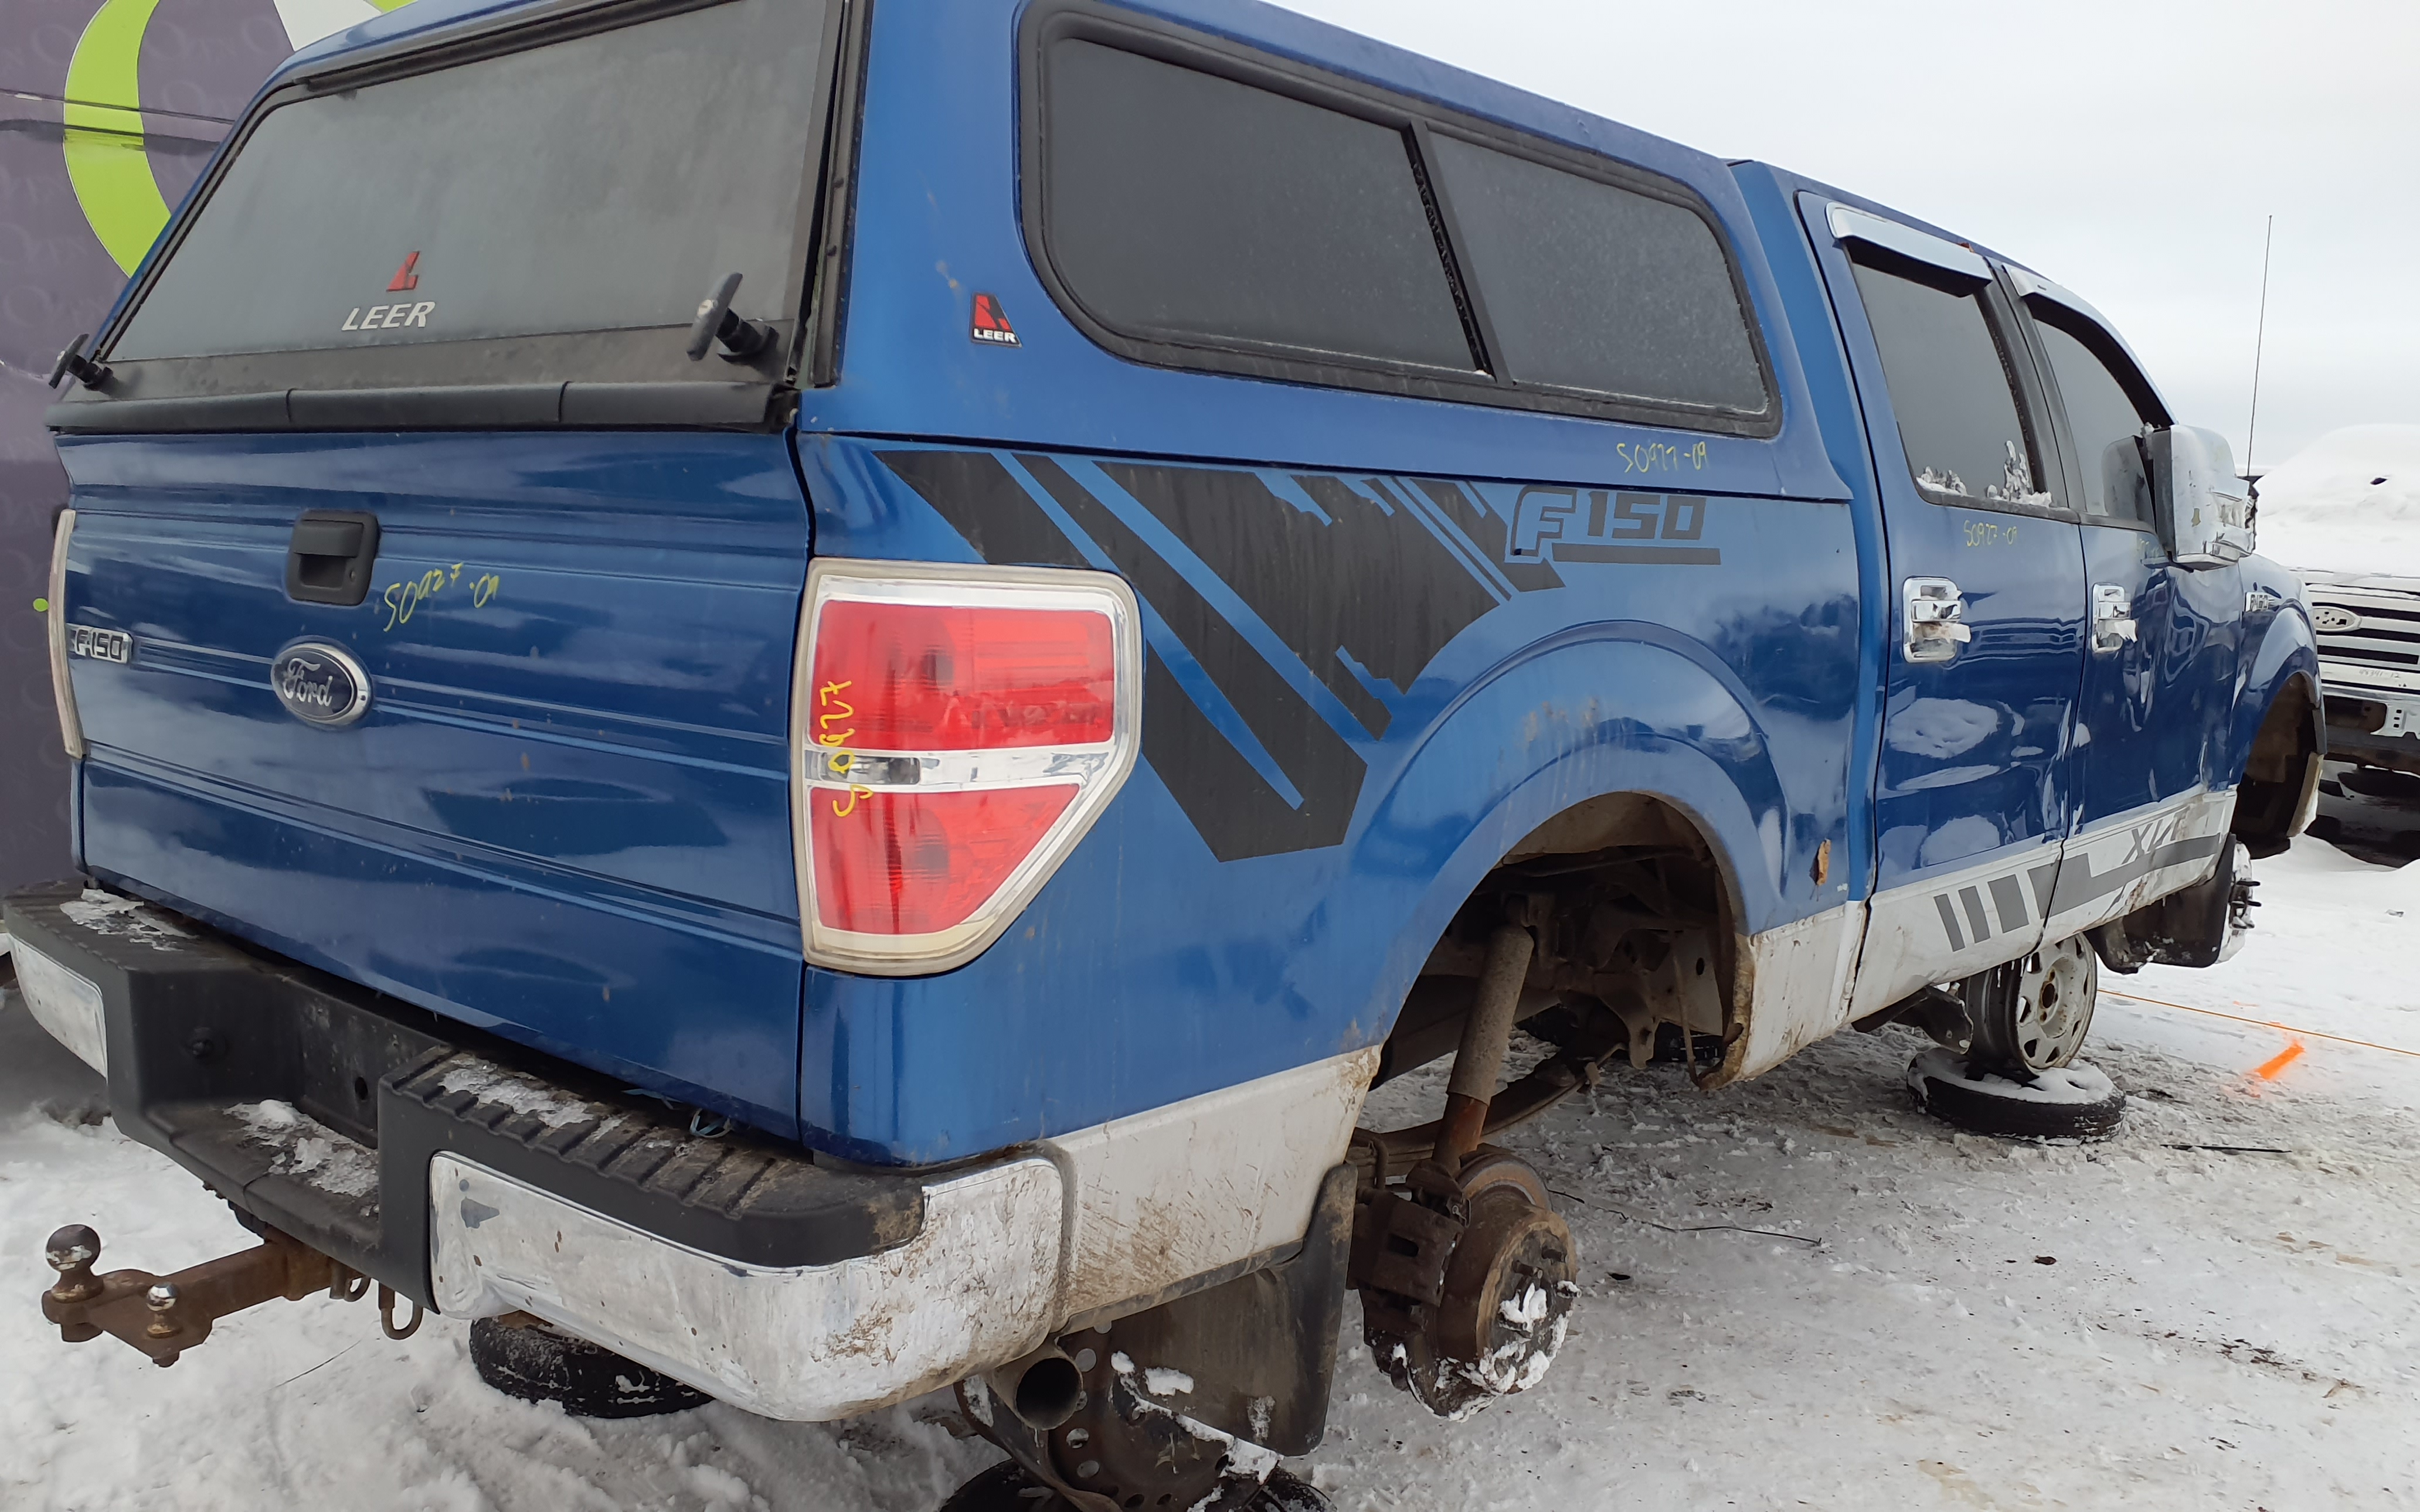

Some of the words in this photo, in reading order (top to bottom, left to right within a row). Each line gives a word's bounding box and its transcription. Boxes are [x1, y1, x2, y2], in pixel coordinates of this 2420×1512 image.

[341, 301, 436, 331] LEER
[973, 328, 1018, 343] LEER
[282, 657, 334, 707] Ford
